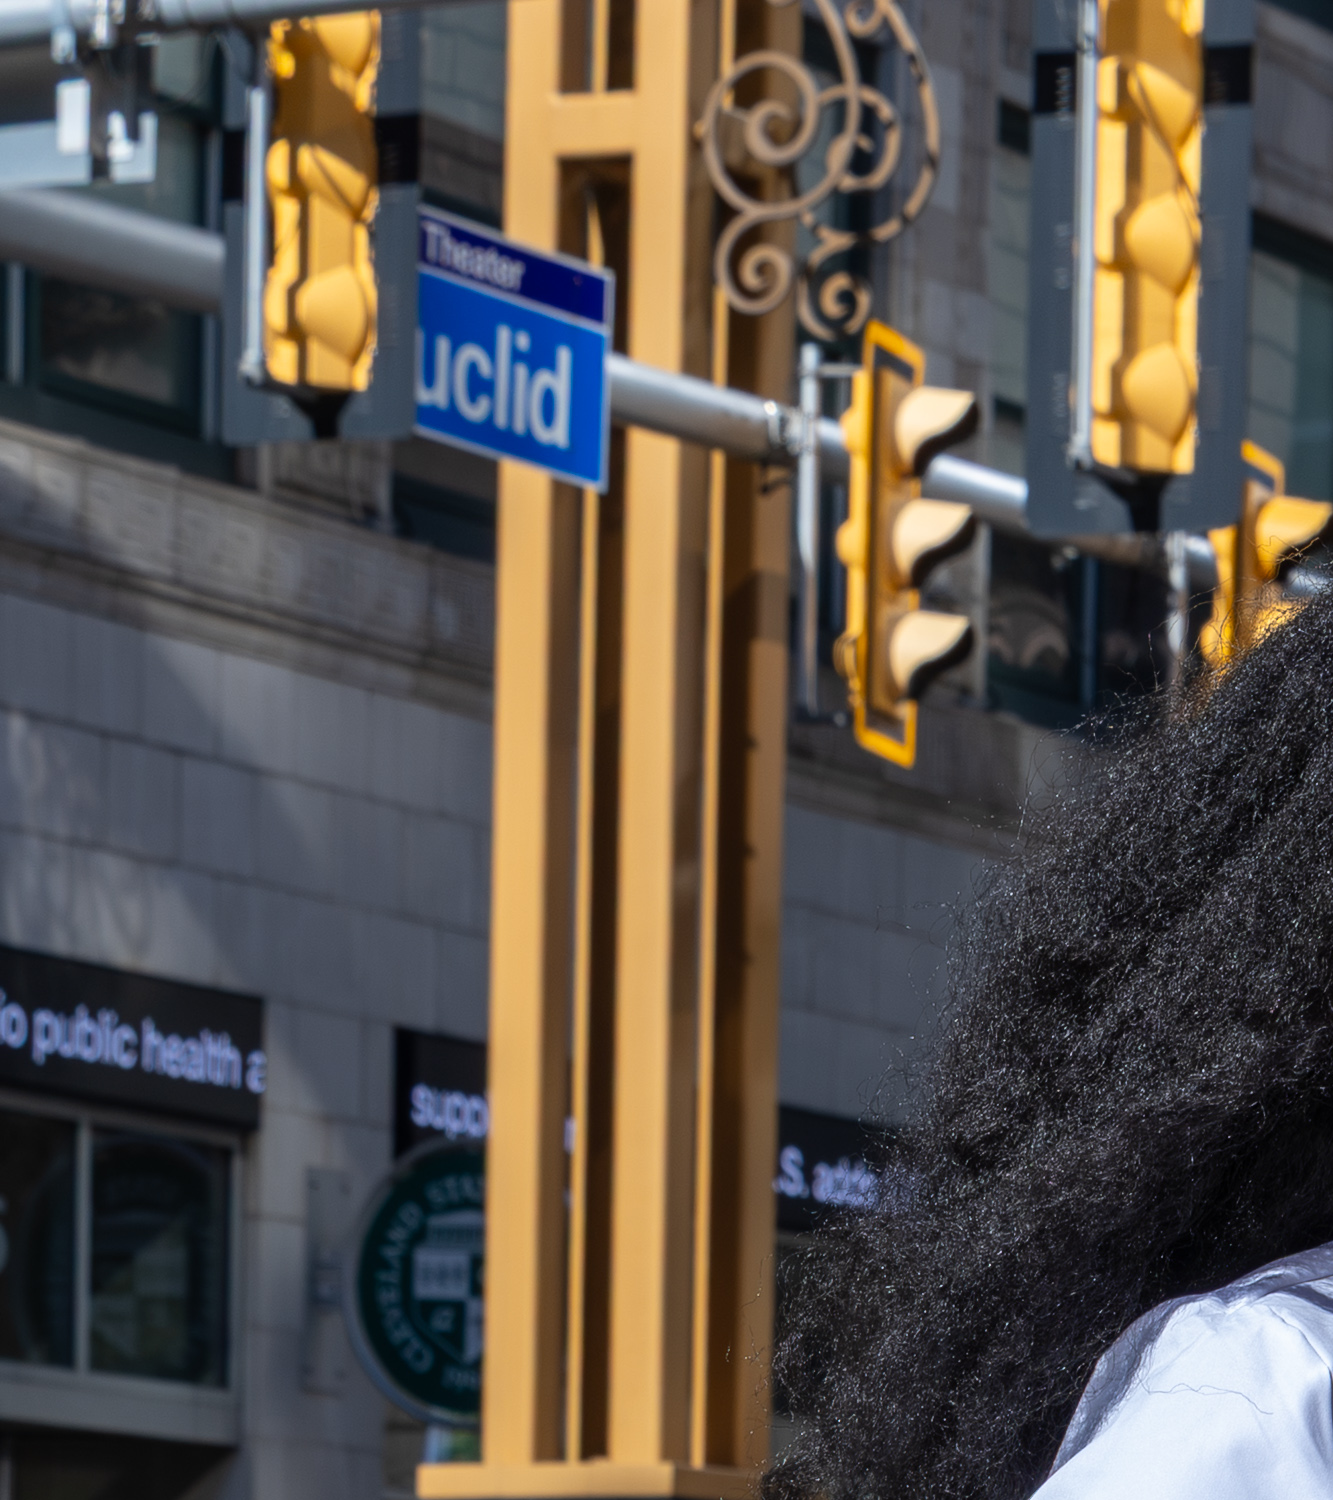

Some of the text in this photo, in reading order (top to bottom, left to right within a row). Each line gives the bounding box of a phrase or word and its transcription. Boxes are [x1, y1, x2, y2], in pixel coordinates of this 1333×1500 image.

[422, 220, 526, 291] Theater
[416, 323, 573, 449] uclid
[32, 1004, 138, 1066] public
[141, 1016, 243, 1090] health
[411, 1083, 489, 1141] supp
